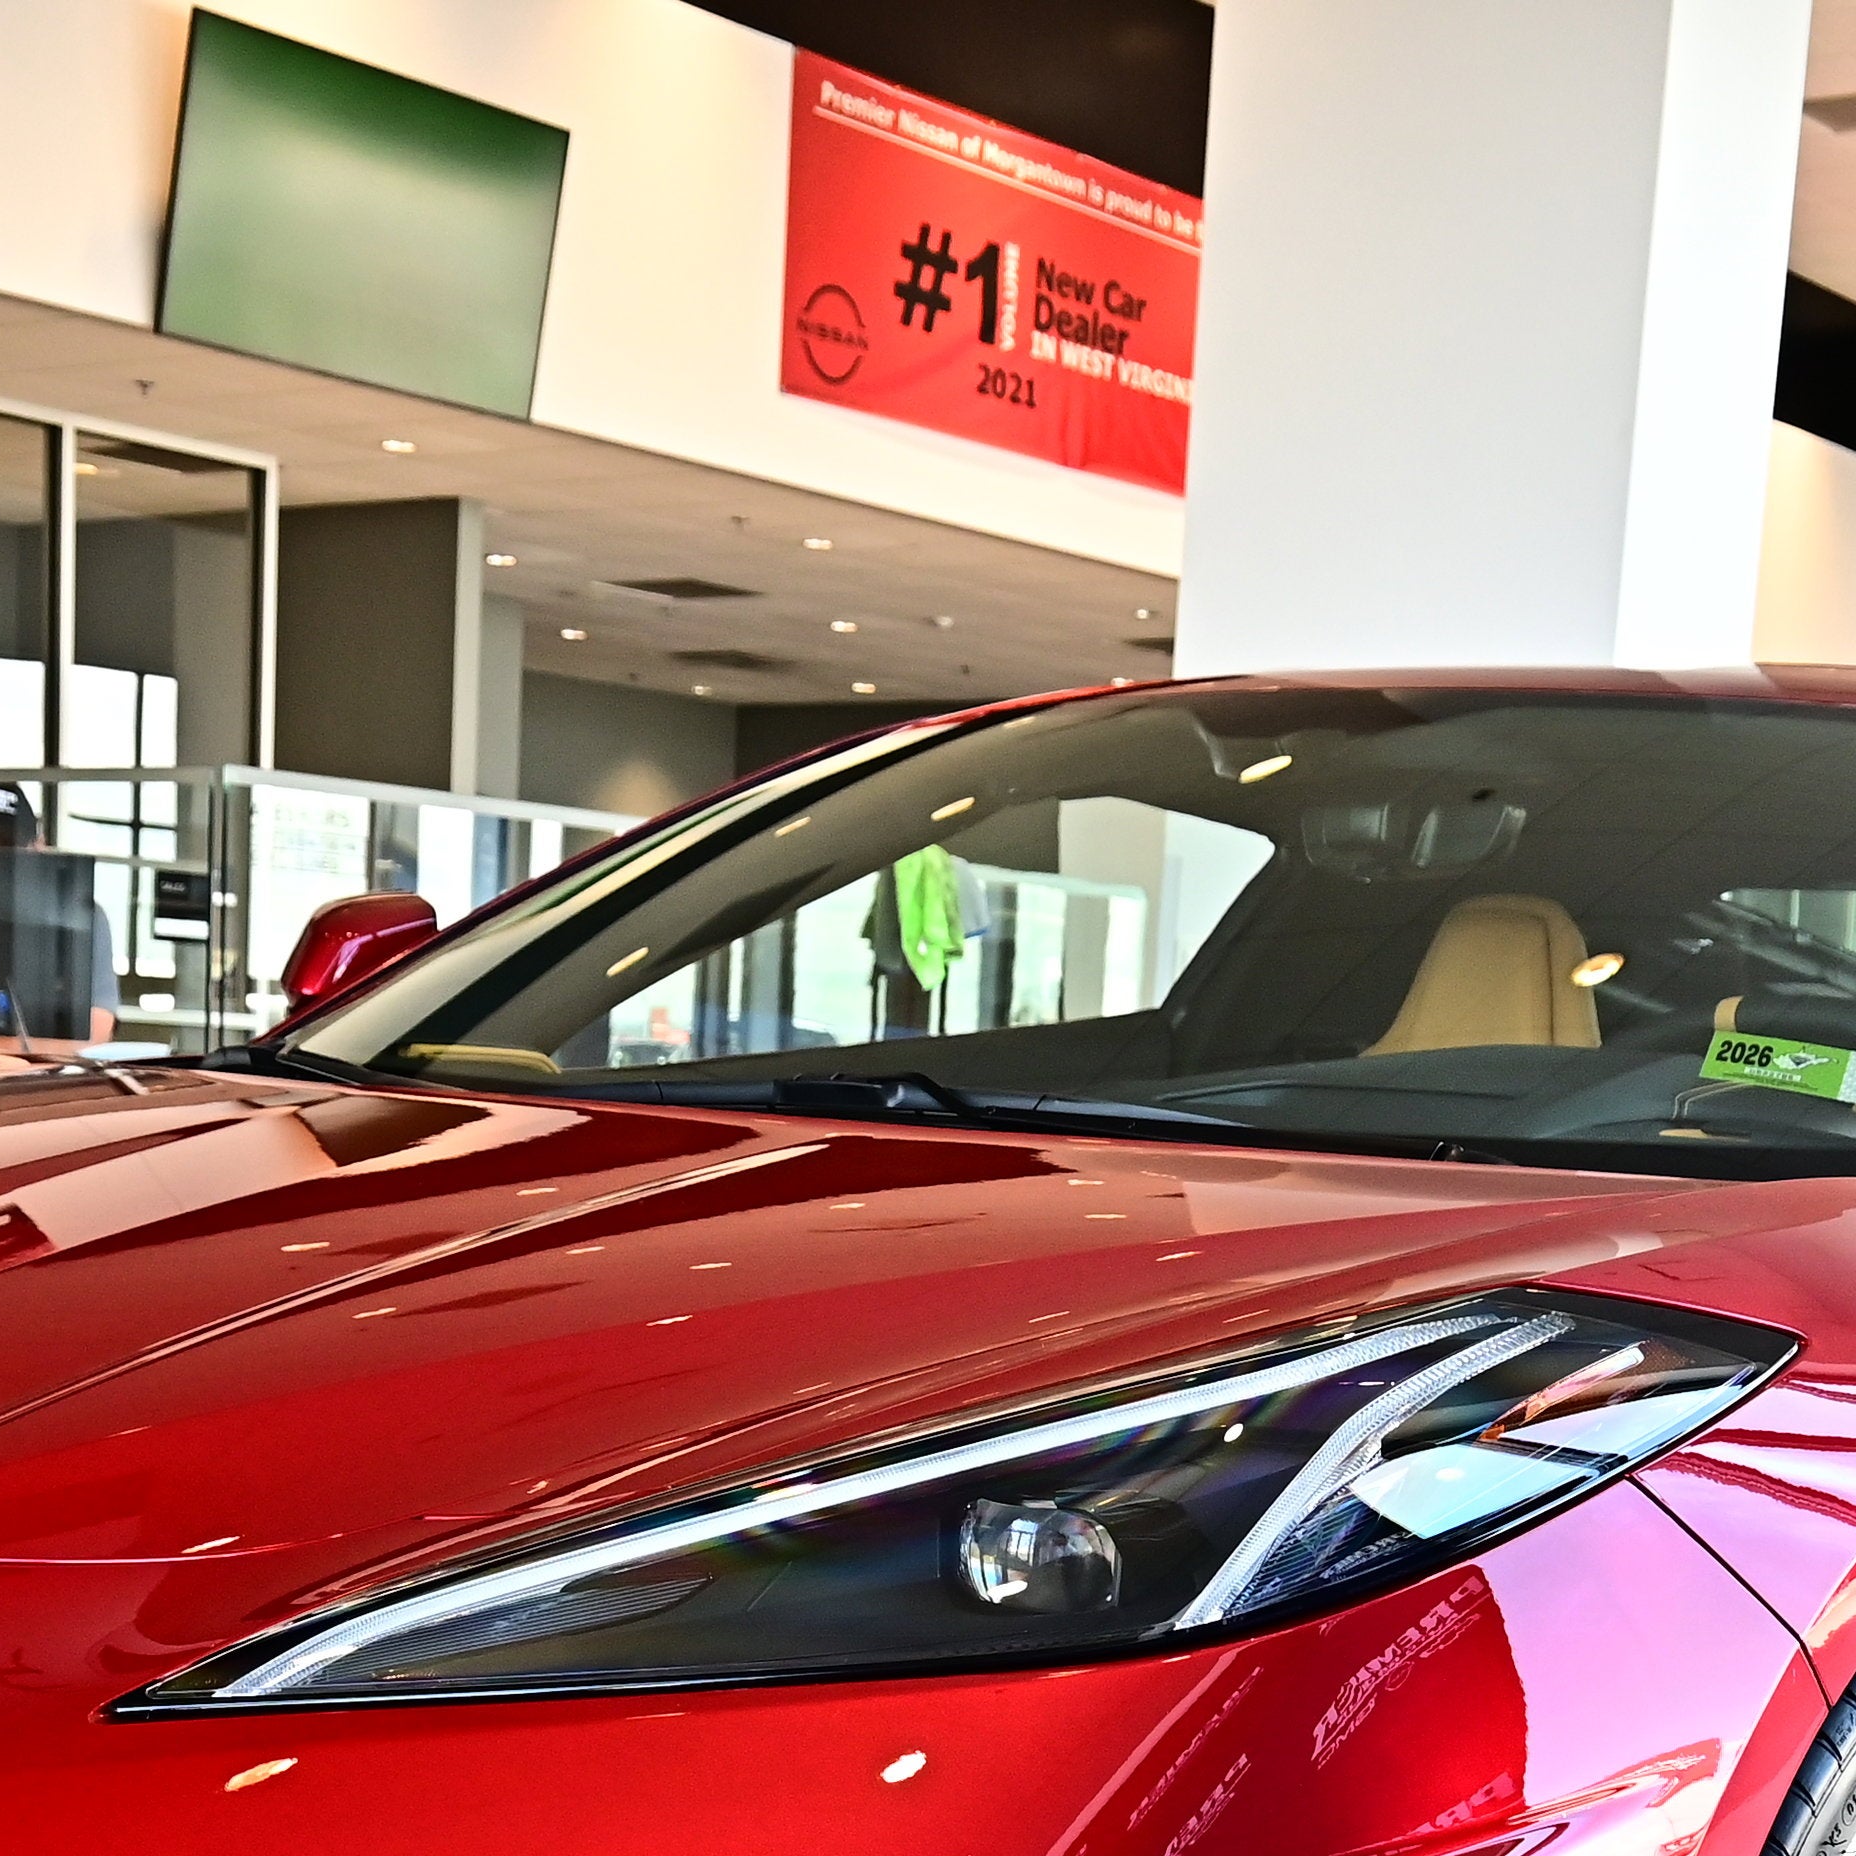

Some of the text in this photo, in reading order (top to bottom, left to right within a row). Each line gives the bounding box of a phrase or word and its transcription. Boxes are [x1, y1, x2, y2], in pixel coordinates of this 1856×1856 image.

[821, 80, 895, 129] Premier
[897, 109, 959, 152] Nissan
[960, 135, 982, 159] of
[982, 139, 1088, 196] Morgantown
[1088, 178, 1104, 206] is
[1104, 190, 1153, 224] proud
[1153, 204, 1172, 231] to
[1173, 210, 1194, 240] be
[893, 222, 1001, 345] #1
[1037, 257, 1146, 322] New Car
[796, 316, 869, 350] NISSAN
[1034, 292, 1130, 355] Dealer
[1030, 330, 1057, 363] IN
[1060, 338, 1116, 381] WEST
[976, 362, 1037, 408] 2021
[1715, 1040, 1774, 1067] 2026
